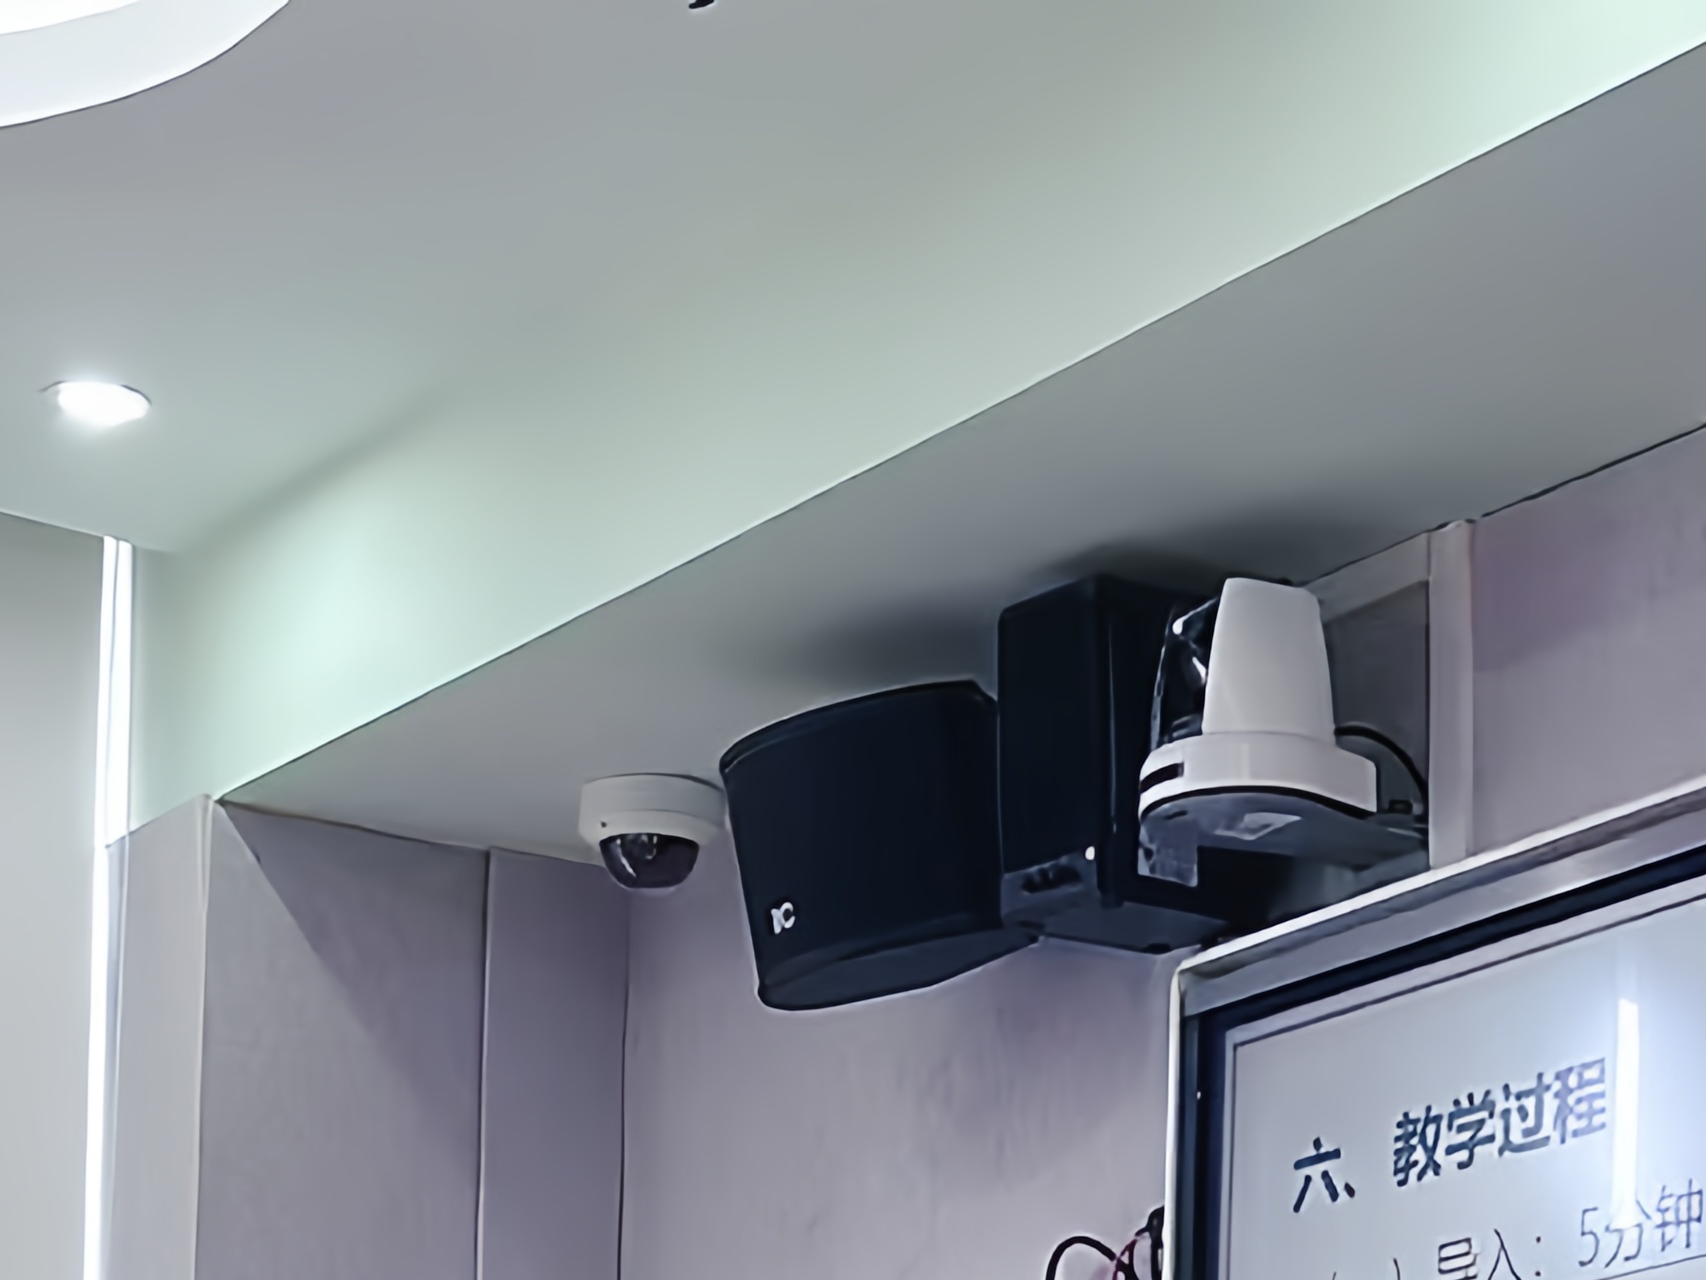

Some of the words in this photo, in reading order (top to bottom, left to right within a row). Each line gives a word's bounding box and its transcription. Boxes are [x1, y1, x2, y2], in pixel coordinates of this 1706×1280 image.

[1293, 1057, 1607, 1213] 六、教学过程
